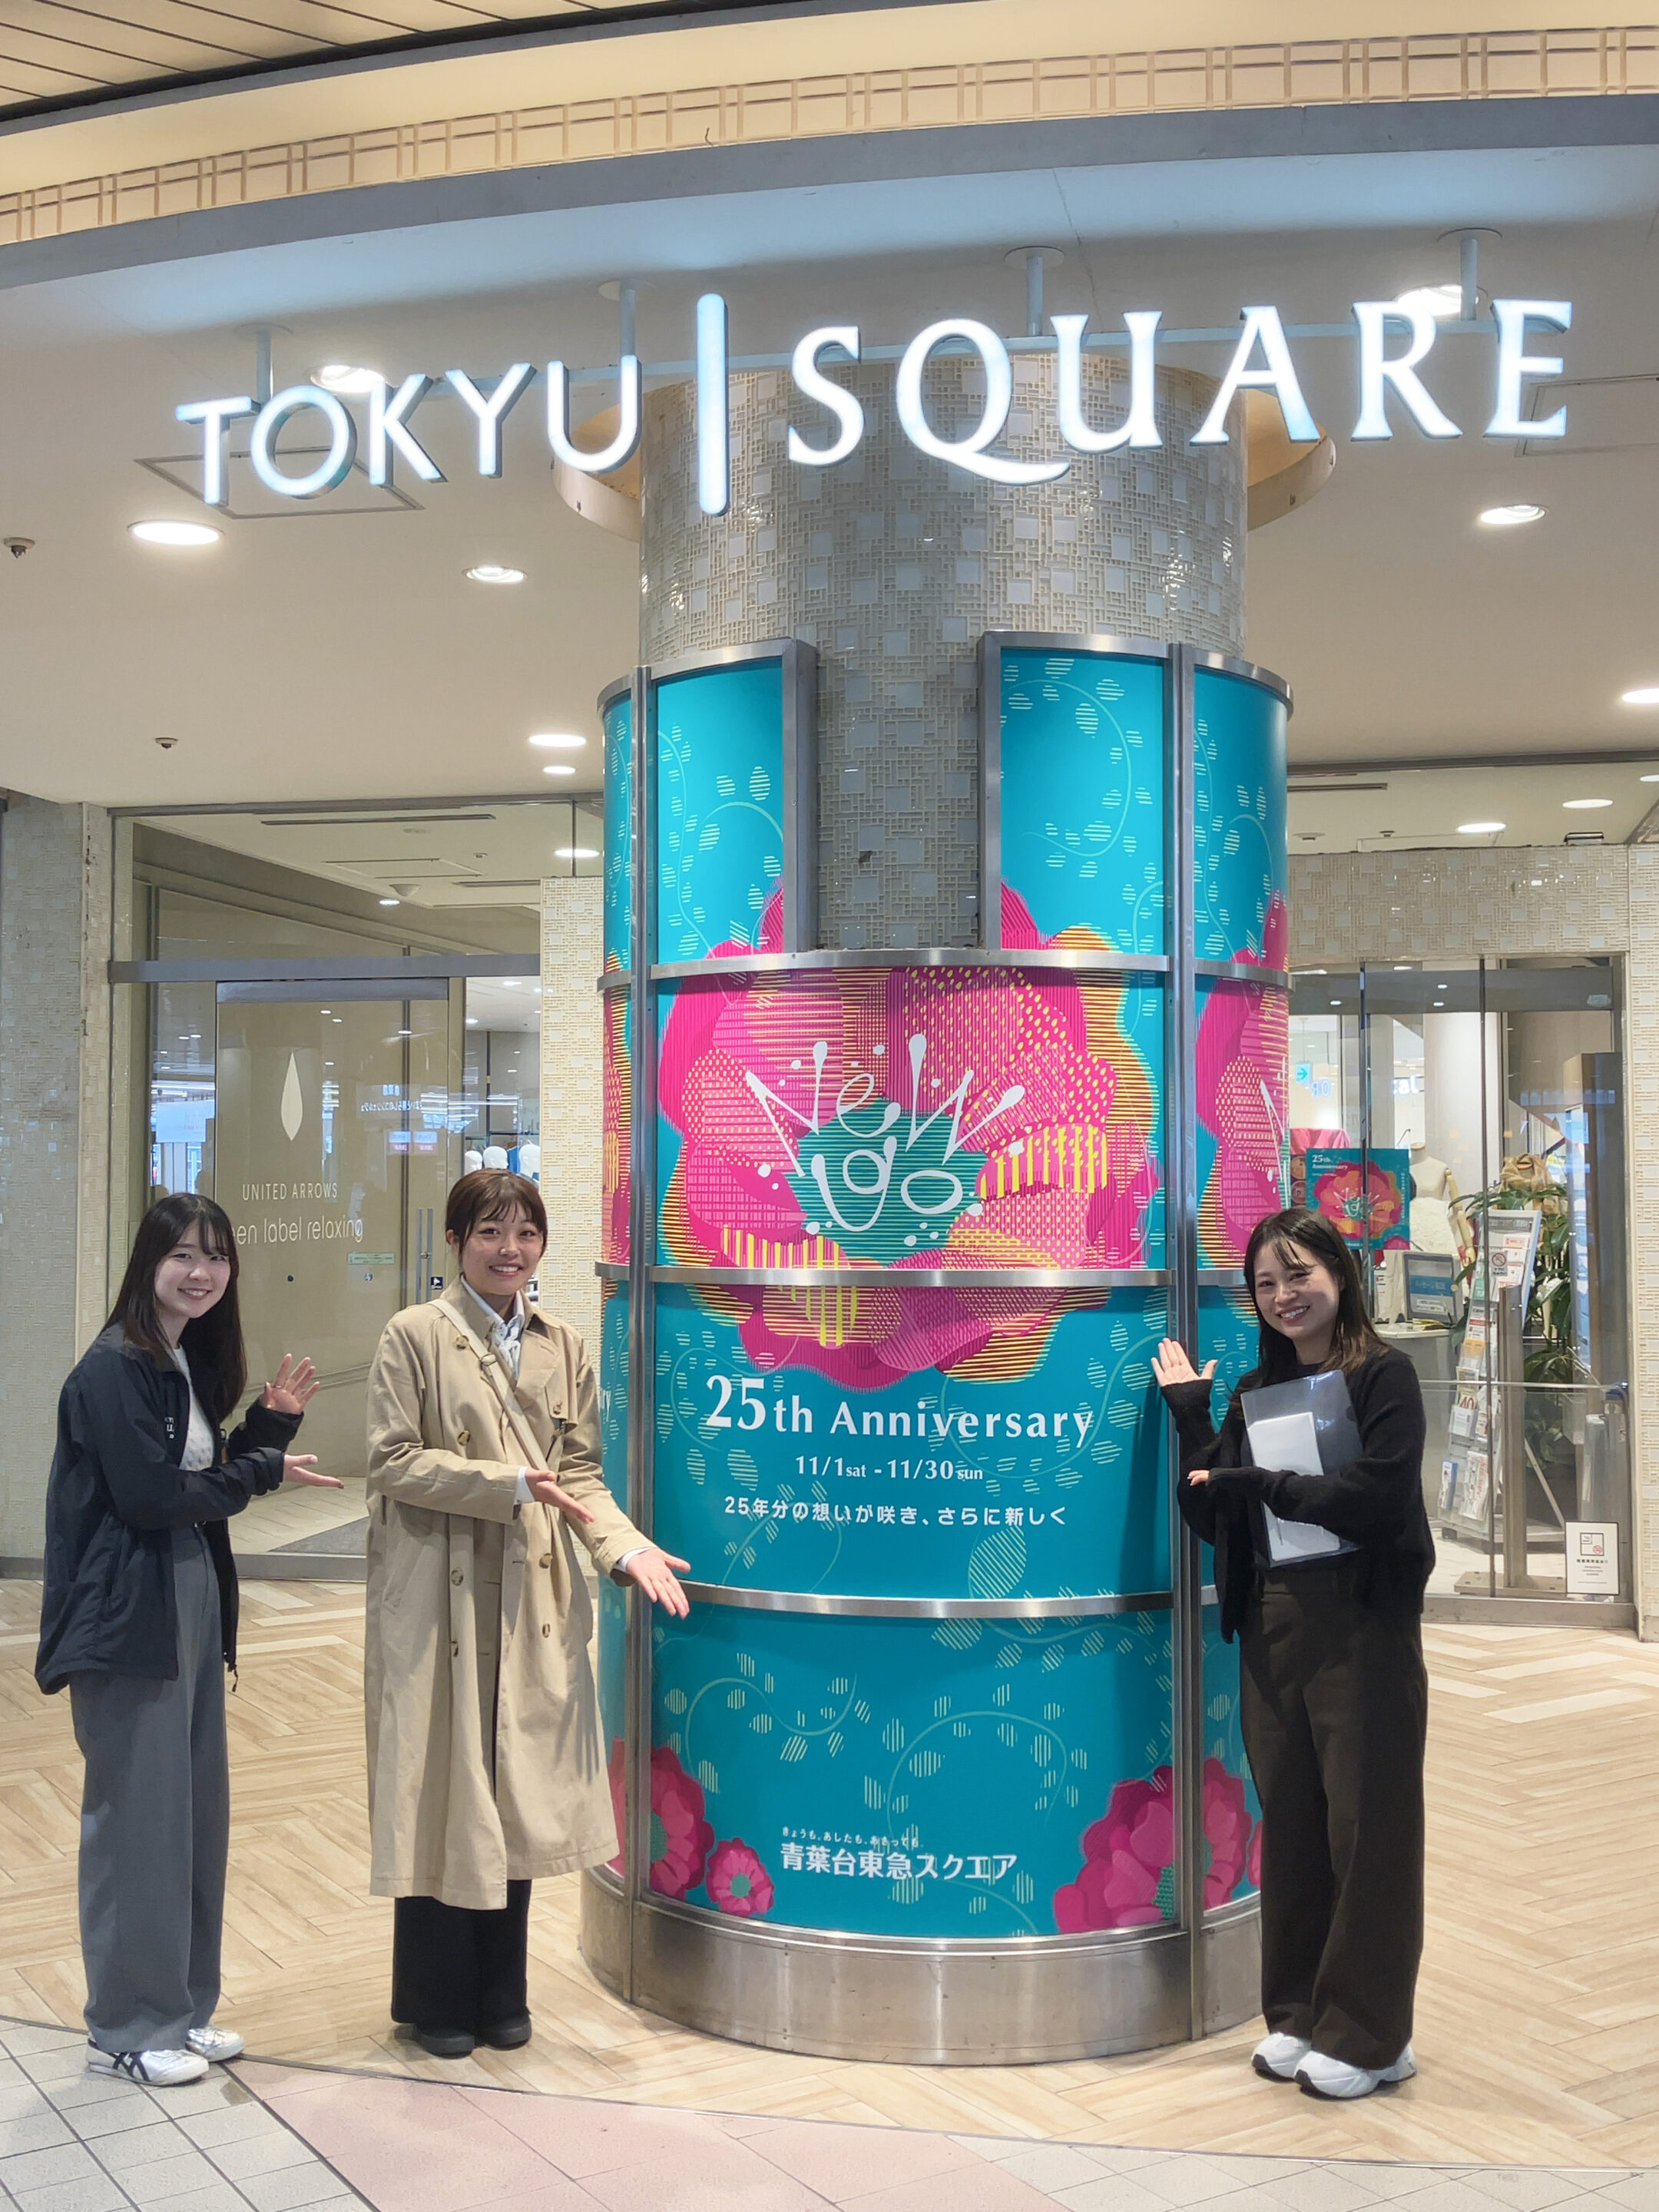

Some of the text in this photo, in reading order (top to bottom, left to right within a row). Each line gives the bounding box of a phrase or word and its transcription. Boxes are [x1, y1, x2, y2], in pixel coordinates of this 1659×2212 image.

[175, 299, 1574, 507] TOKYU SQUARE
[242, 1182, 338, 1200] UNITED ARROWS
[263, 1216, 302, 1243] label
[306, 1214, 363, 1243] relaxing
[706, 1375, 1094, 1449] 25th Anniversary
[724, 1496, 1067, 1528] 25年分の想いが咲き、さらに新しく
[780, 1843, 1018, 1881] 青葉台東急スクエア
